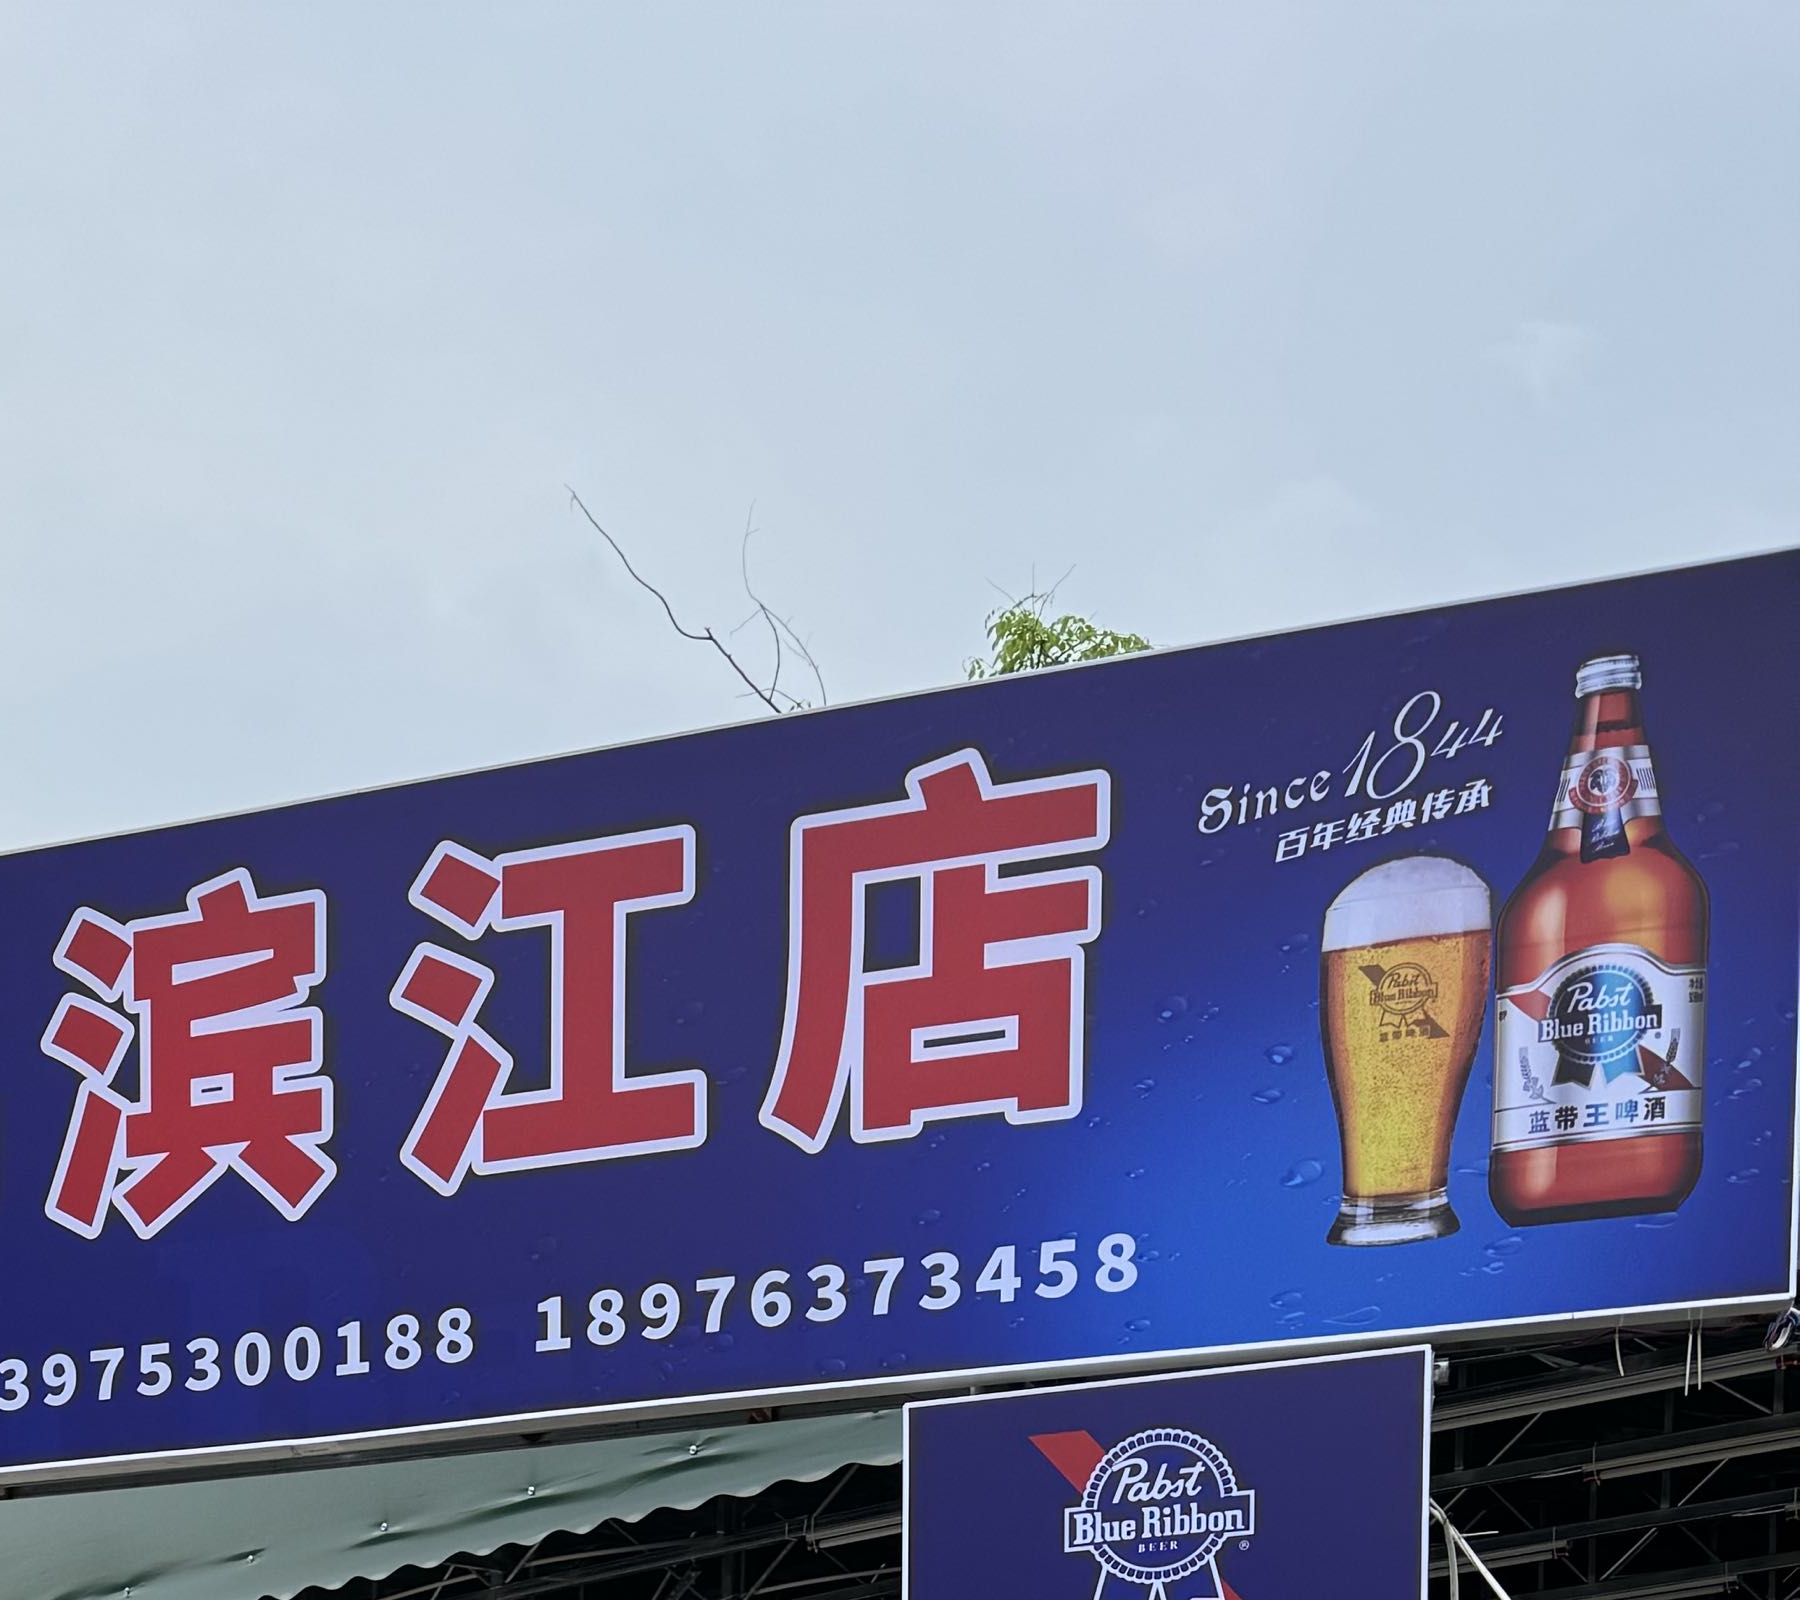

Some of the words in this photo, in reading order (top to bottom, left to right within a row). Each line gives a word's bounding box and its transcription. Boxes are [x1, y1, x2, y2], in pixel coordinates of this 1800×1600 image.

[1198, 770, 1331, 834] Since
[1342, 690, 1503, 800] 1844
[1275, 778, 1493, 863] 百年经典传承
[1566, 981, 1634, 1014] Pabst
[1540, 1018, 1584, 1042] Blue
[1587, 1010, 1659, 1036] Ribbon
[1528, 1096, 1667, 1135] 蓝带王啤酒
[535, 1233, 1138, 1353] 18976373458
[1111, 1457, 1206, 1504] Pabst
[1073, 1511, 1137, 1546] Blue
[1140, 1502, 1245, 1539] Ribbon
[1138, 1540, 1179, 1554] BEER
